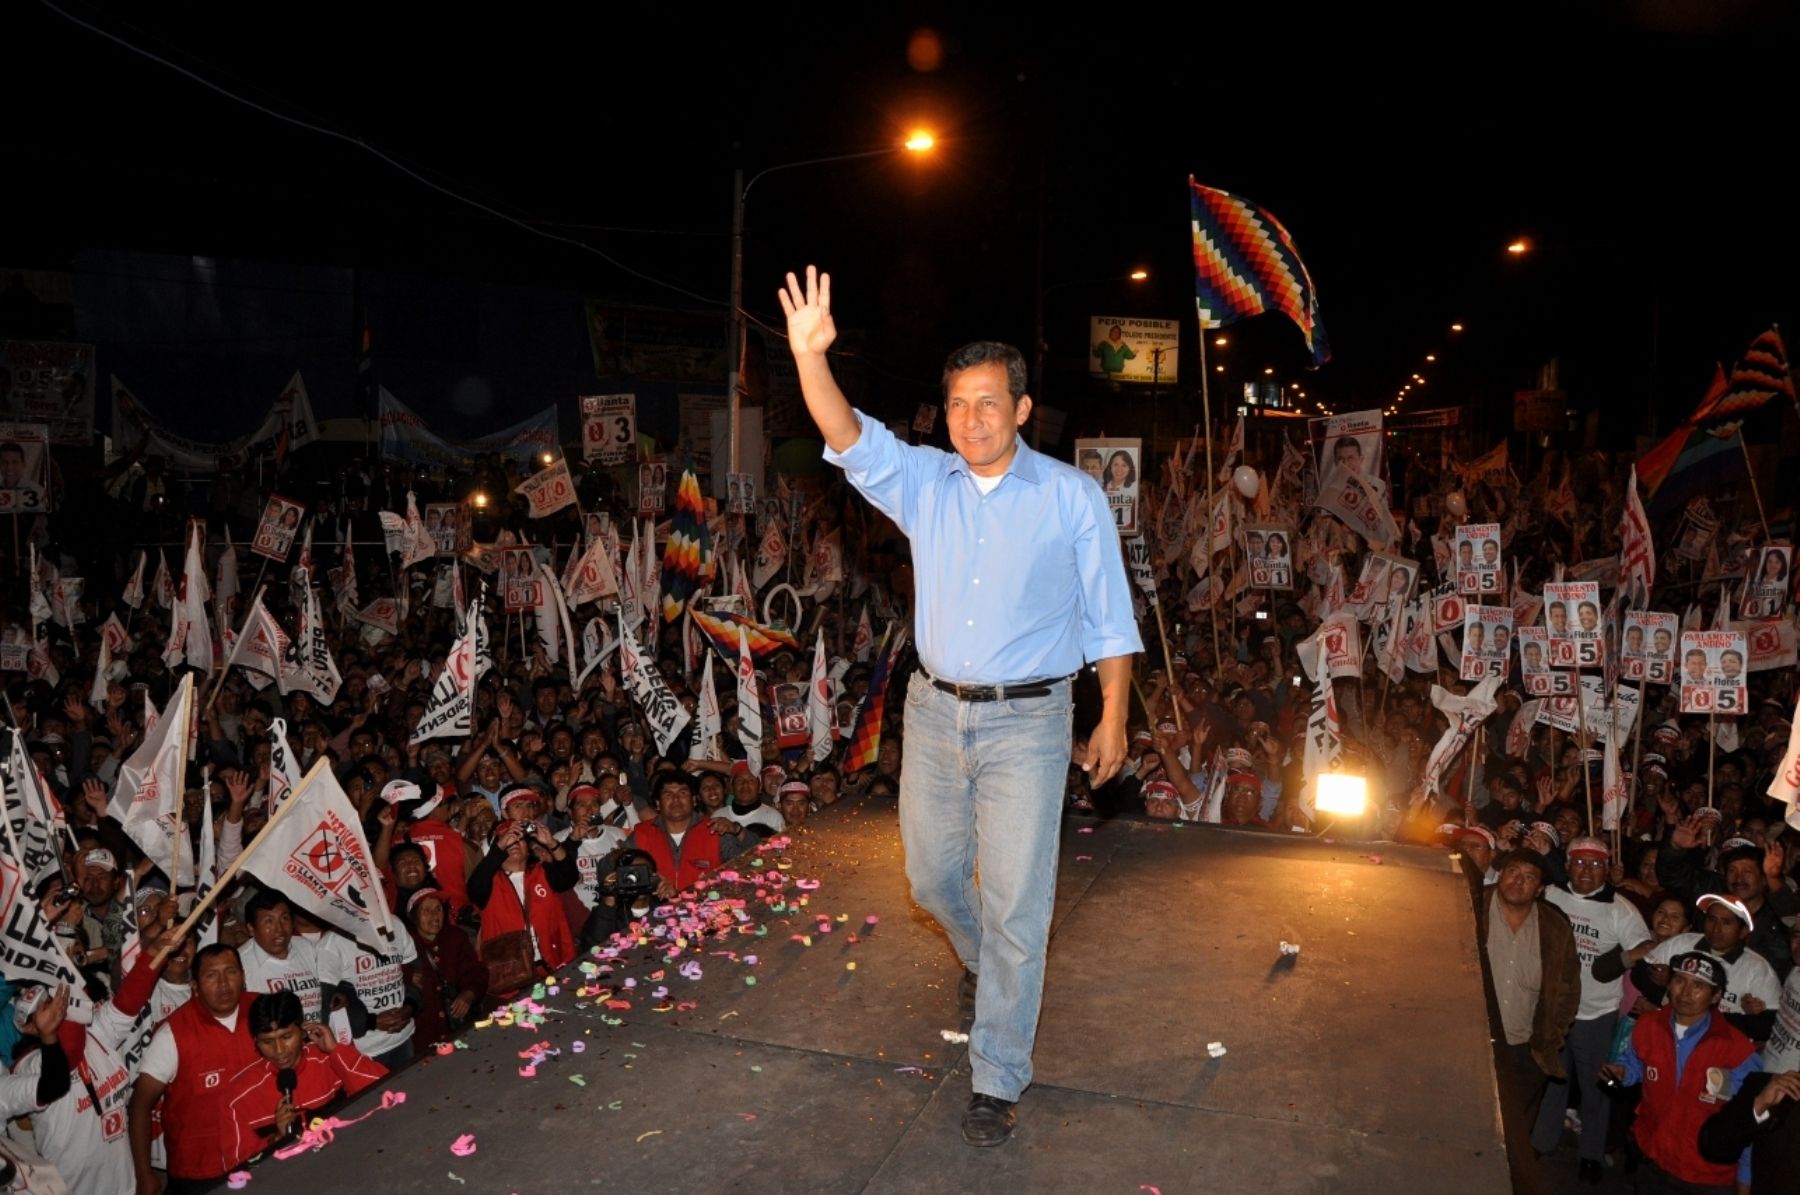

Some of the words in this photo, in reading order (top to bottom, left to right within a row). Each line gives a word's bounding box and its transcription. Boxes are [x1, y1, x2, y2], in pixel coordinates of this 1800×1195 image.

[1098, 318, 1126, 326] PERU
[1129, 319, 1171, 329] POSIBLE
[615, 418, 630, 442] 3
[23, 491, 39, 507] 3
[1481, 573, 1495, 589] 5
[1546, 584, 1596, 592] PARLAMENTO
[1575, 631, 1598, 639] Flores
[1579, 643, 1596, 662] 5
[1695, 641, 1733, 649] ANDINO
[1489, 661, 1502, 677] 5
[1649, 662, 1664, 679] 5
[1553, 675, 1569, 692] 5
[1713, 677, 1741, 687] Flores
[1717, 690, 1737, 709] 5
[373, 990, 402, 1010] 2011
